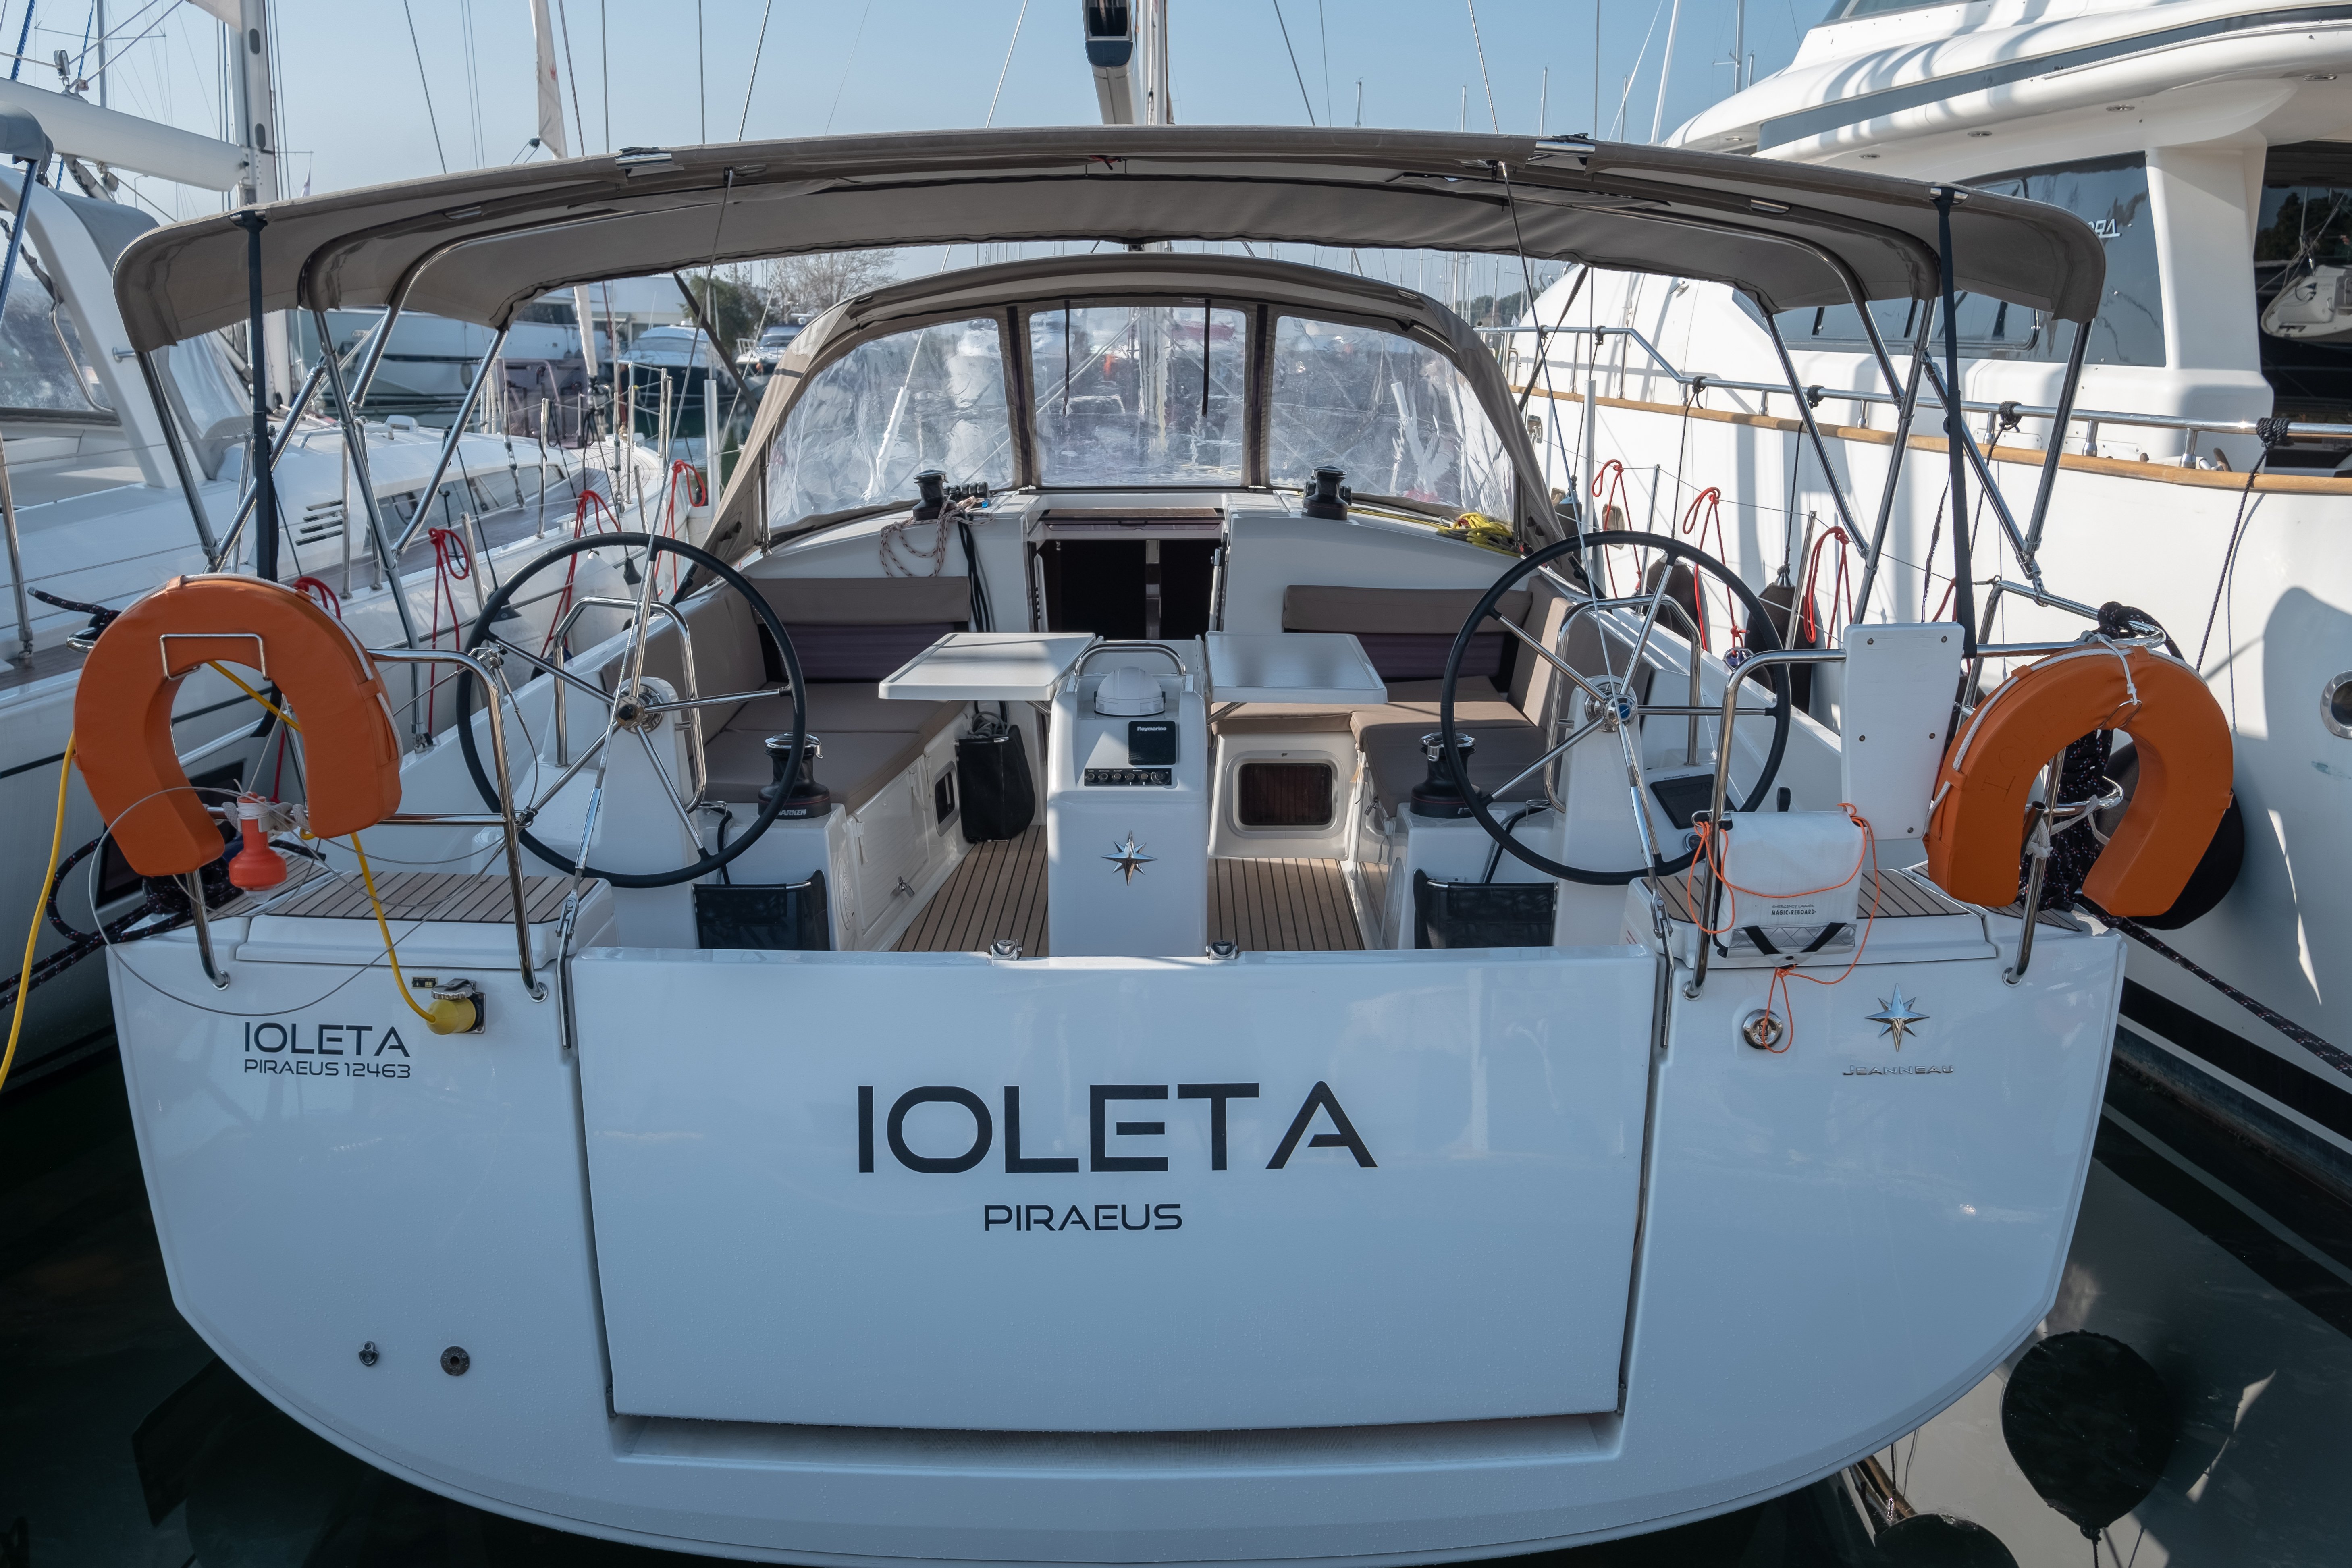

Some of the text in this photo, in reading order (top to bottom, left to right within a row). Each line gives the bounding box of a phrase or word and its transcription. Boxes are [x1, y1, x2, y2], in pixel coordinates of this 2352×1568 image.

[245, 1022, 411, 1057] IOLETA
[244, 1059, 411, 1078] PIRAEUS 12463
[1842, 1065, 1954, 1076] JEANNEAU
[857, 1081, 1378, 1174] IOLETA
[984, 1203, 1183, 1232] PIRAEUS
